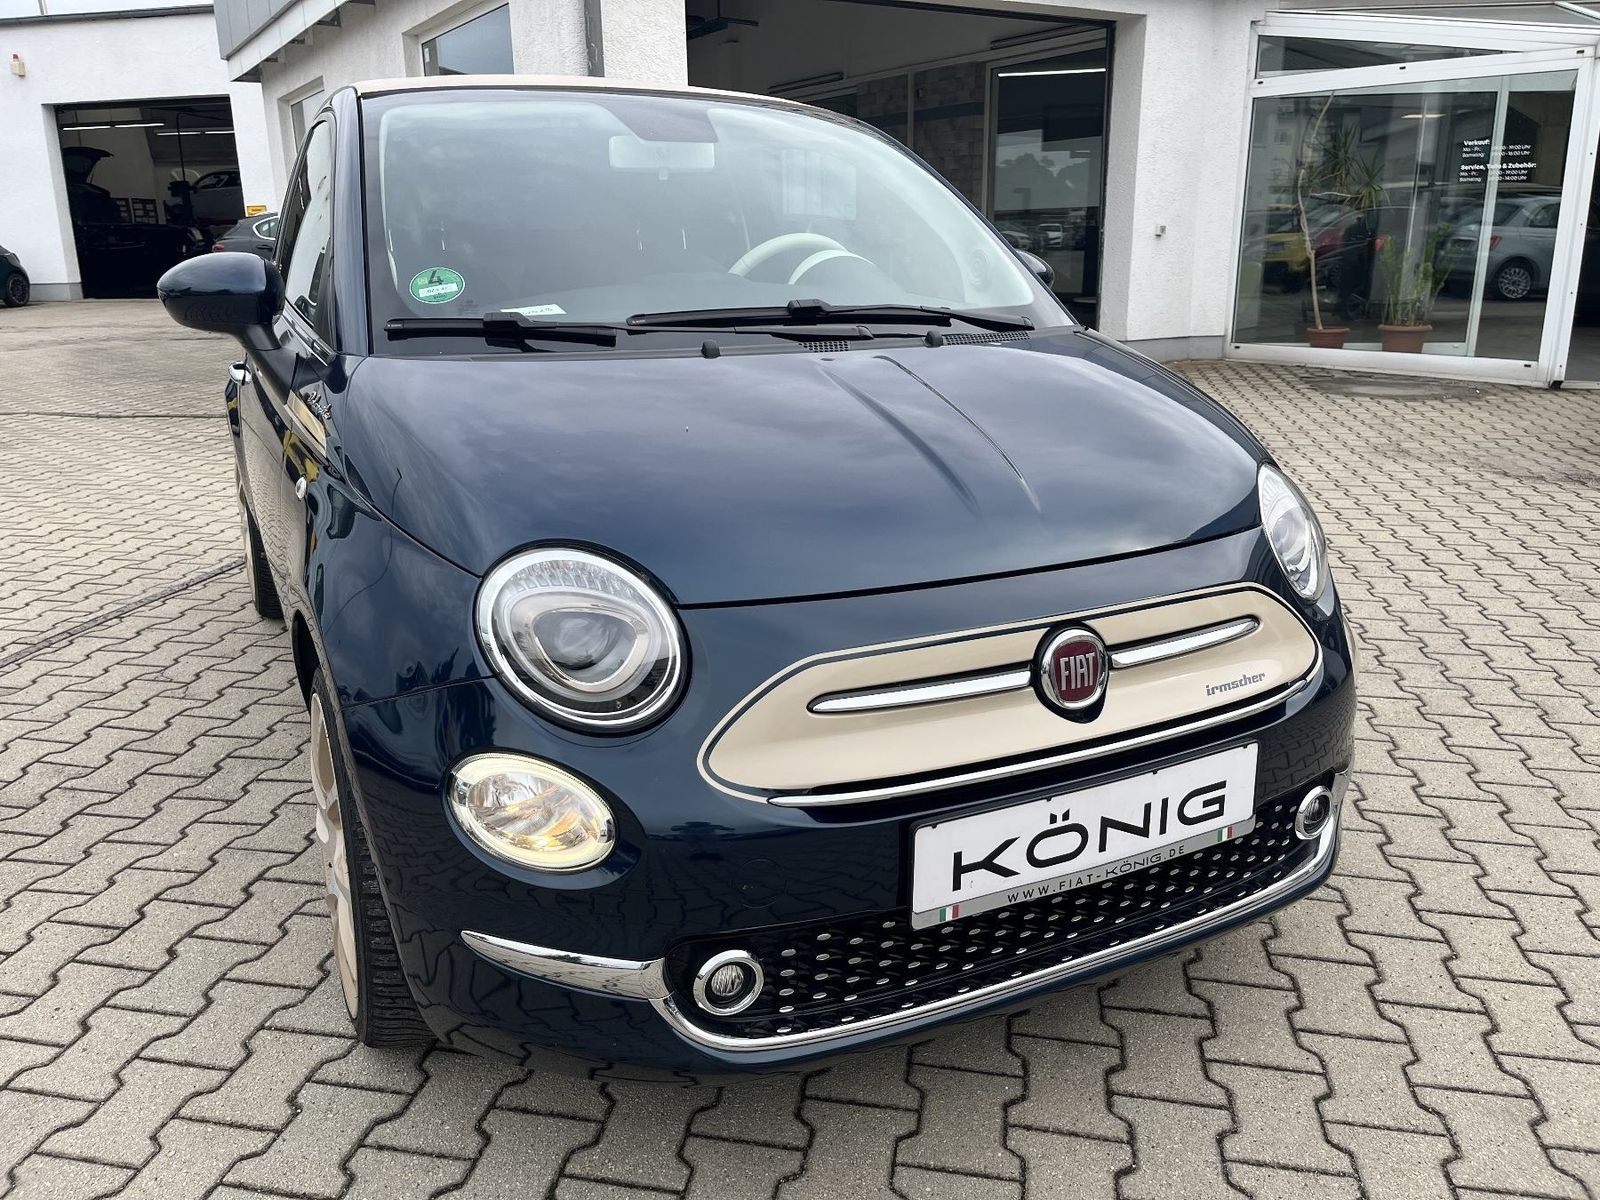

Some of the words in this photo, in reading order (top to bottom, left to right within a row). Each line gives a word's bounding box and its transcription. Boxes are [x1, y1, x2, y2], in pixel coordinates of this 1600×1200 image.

[428, 269, 444, 285] 4
[1060, 652, 1095, 691] FIAT
[1206, 672, 1266, 696] irmscher
[952, 780, 1228, 892] KÖNIG
[1007, 845, 1185, 903] WWW.FIAT-KÖNIG.DE
